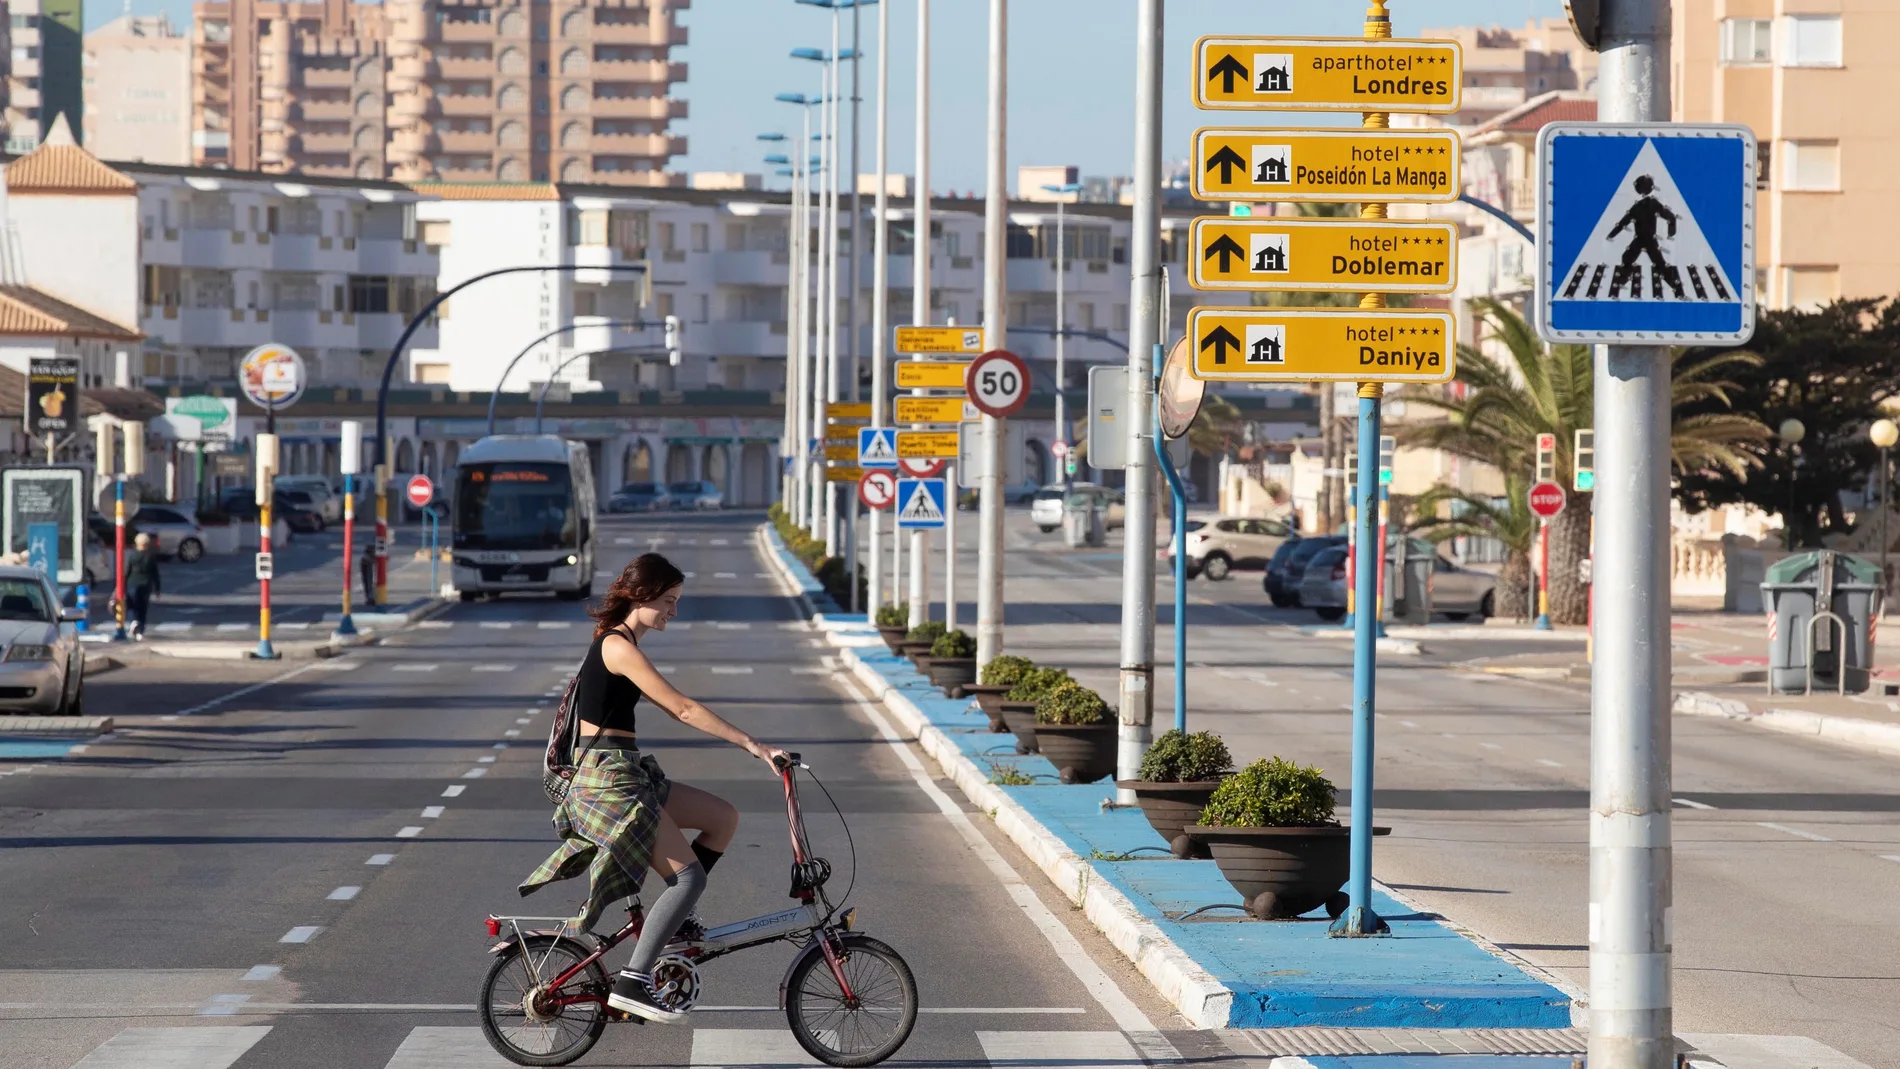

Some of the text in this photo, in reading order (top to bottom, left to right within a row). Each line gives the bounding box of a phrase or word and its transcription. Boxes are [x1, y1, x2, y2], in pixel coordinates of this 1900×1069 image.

[1312, 54, 1412, 73] aparthotel
[1353, 75, 1448, 95] Londres
[1351, 145, 1399, 162] hotel
[1296, 164, 1447, 190] Poseidón La Manga
[1350, 235, 1398, 252] hotel
[1332, 255, 1444, 276] Doblemar
[1346, 325, 1394, 342] hotel
[1359, 346, 1440, 370] Daniya
[982, 371, 1017, 396] 50
[38, 417, 67, 429] OPEN
[1532, 494, 1562, 505] STOP
[747, 911, 798, 930] MONTY
